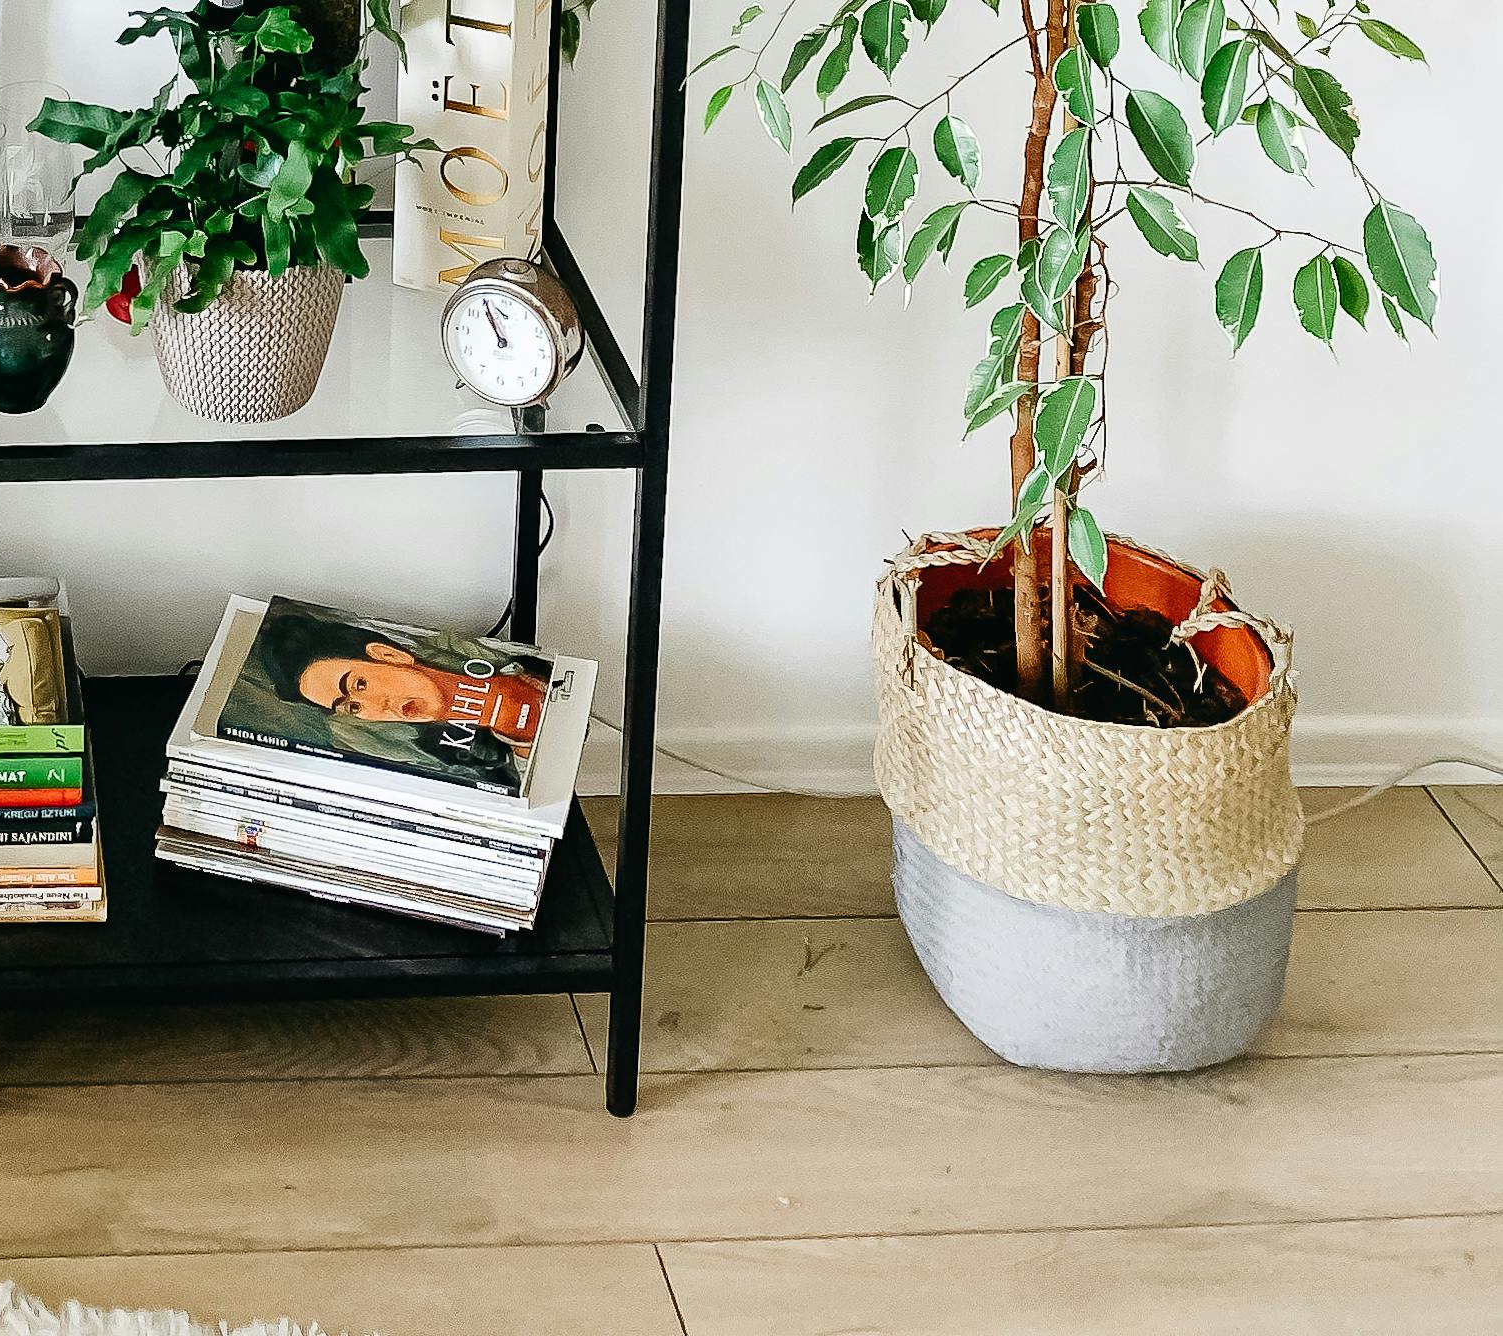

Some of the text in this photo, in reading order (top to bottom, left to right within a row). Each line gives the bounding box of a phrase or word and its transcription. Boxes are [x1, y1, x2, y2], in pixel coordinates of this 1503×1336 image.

[438, 658, 495, 751] KAHLO
[223, 726, 289, 748] FRIDA KAHLO
[10, 831, 73, 844] SAJANDINI
